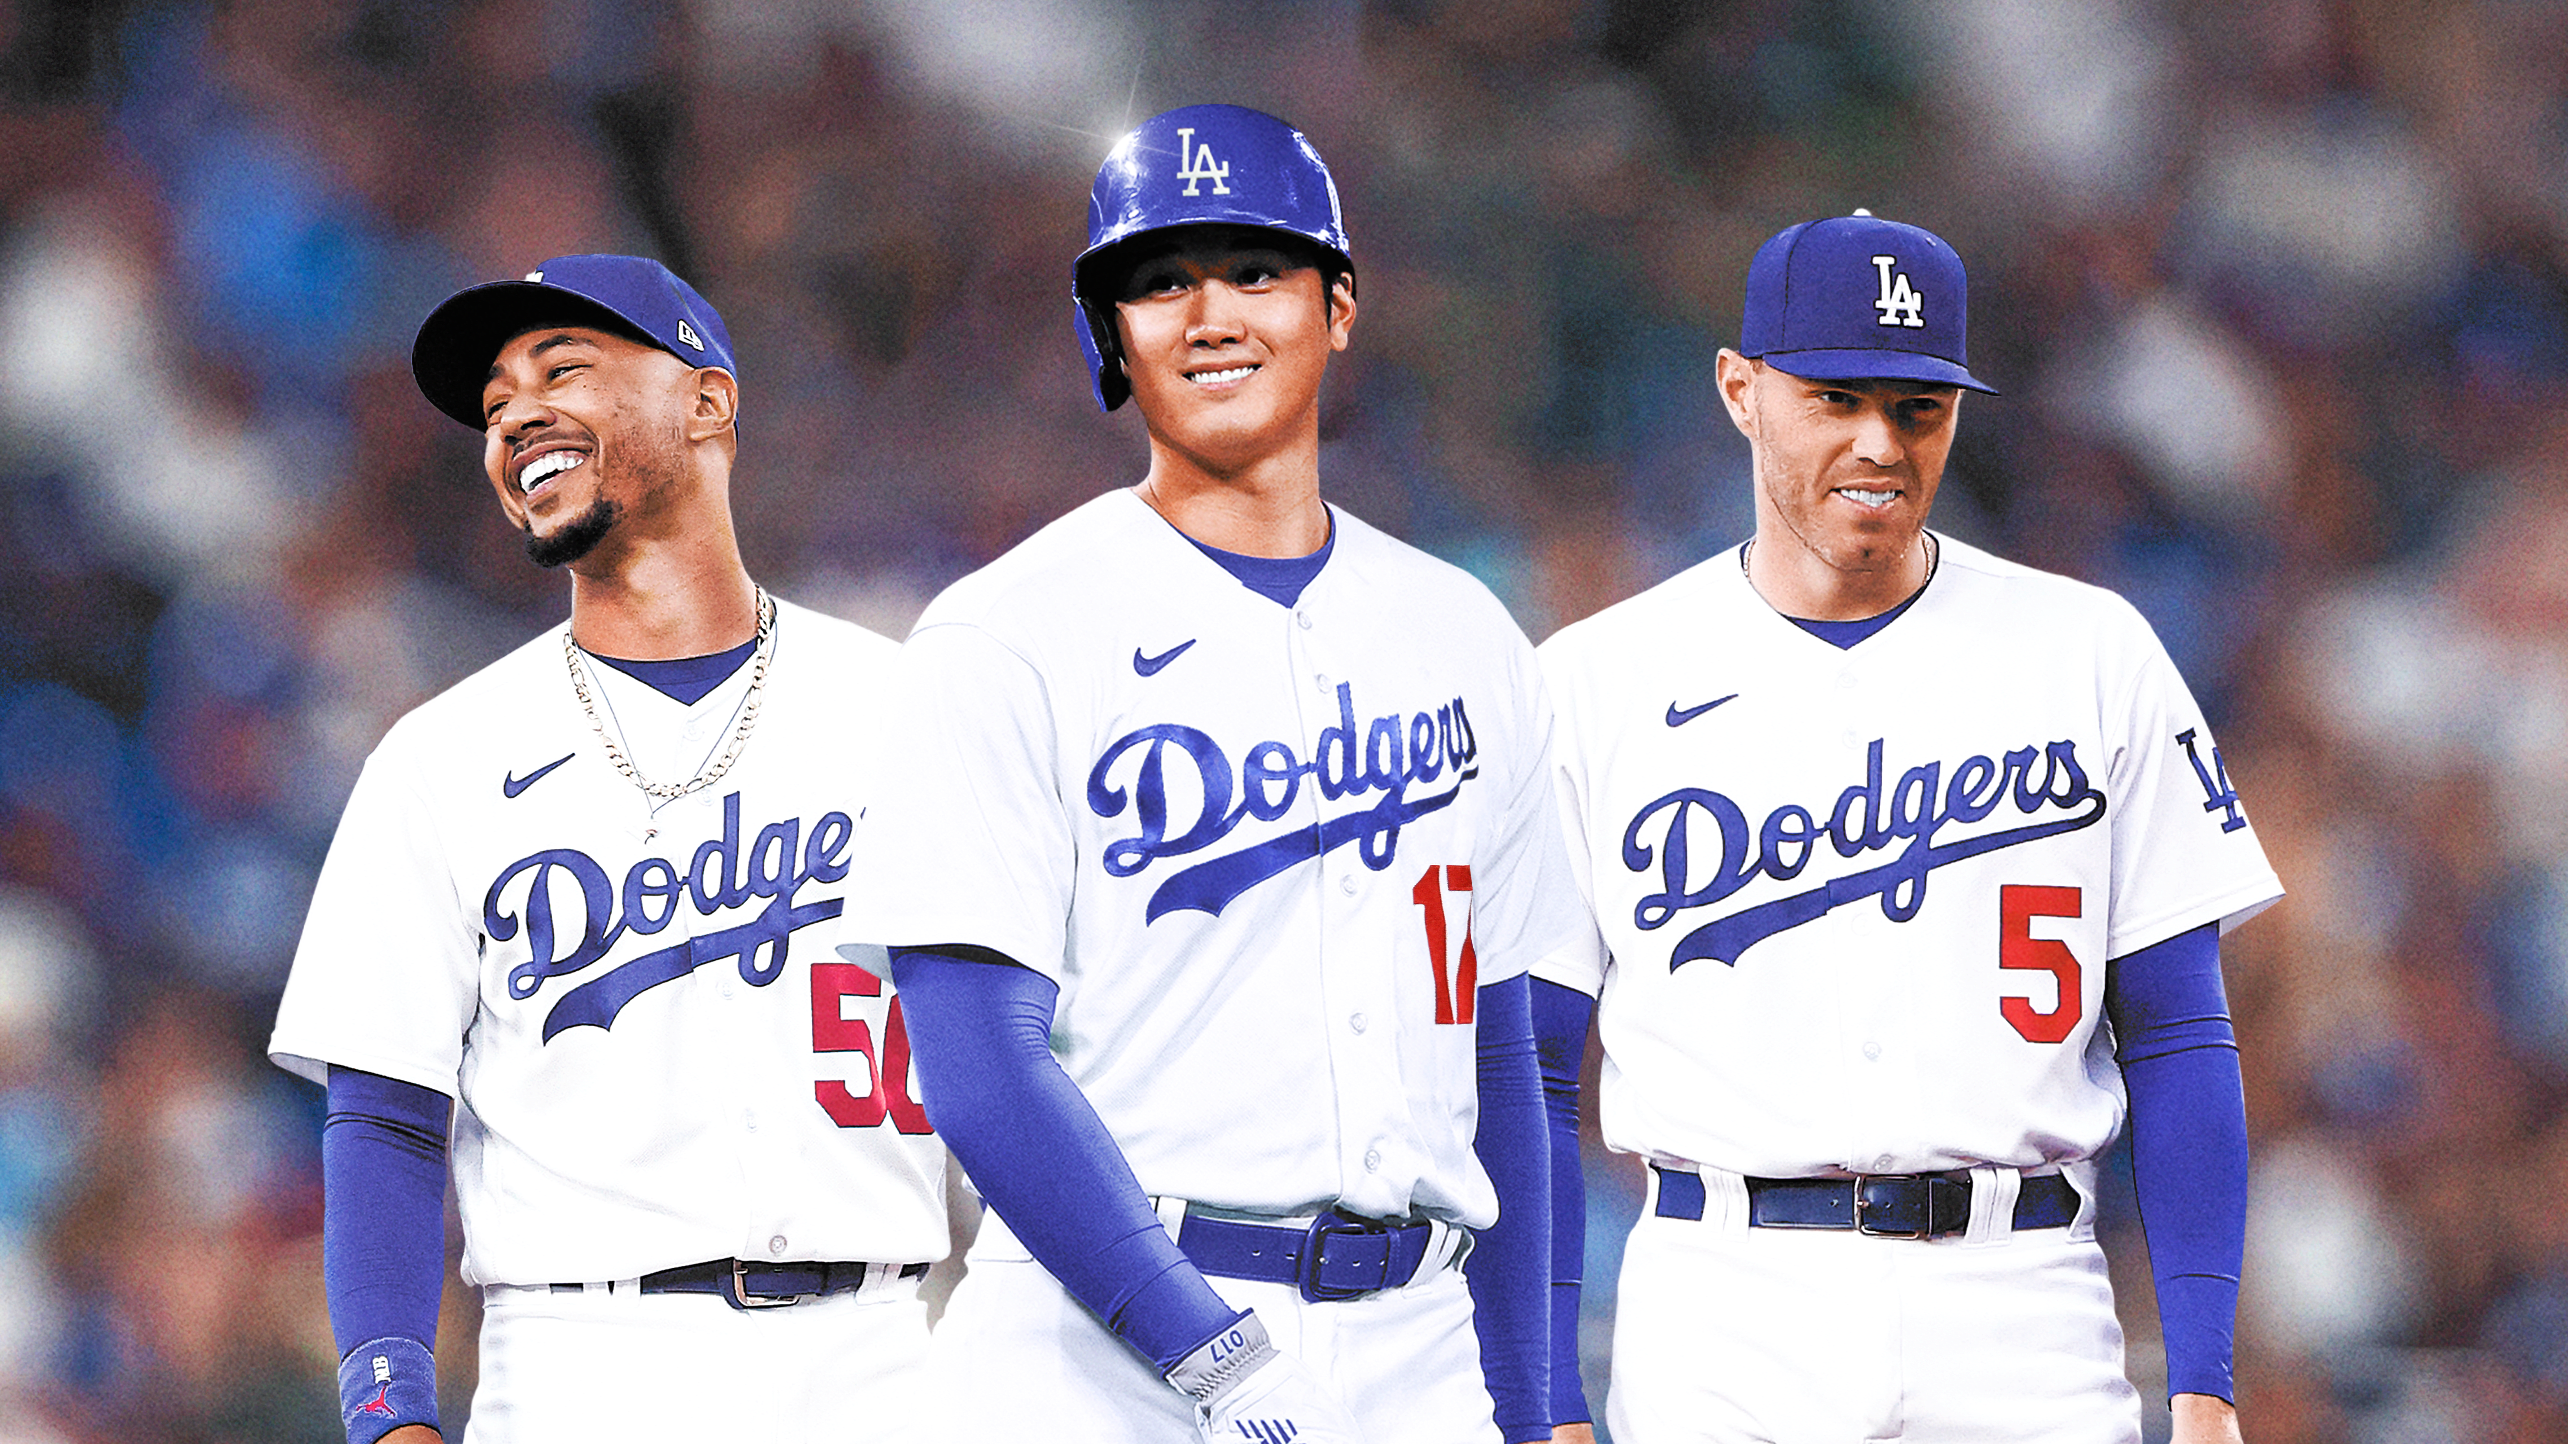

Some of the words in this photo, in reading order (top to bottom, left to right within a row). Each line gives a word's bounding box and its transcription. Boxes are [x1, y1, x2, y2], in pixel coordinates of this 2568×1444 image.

[1177, 128, 1231, 196] LA
[1871, 255, 1925, 328] LA
[1087, 681, 1479, 927] Dodgers
[1622, 737, 2107, 975] Dodgers
[483, 791, 866, 1046] Dodge
[1413, 864, 1478, 1025] 17
[2000, 884, 2082, 1044] 5
